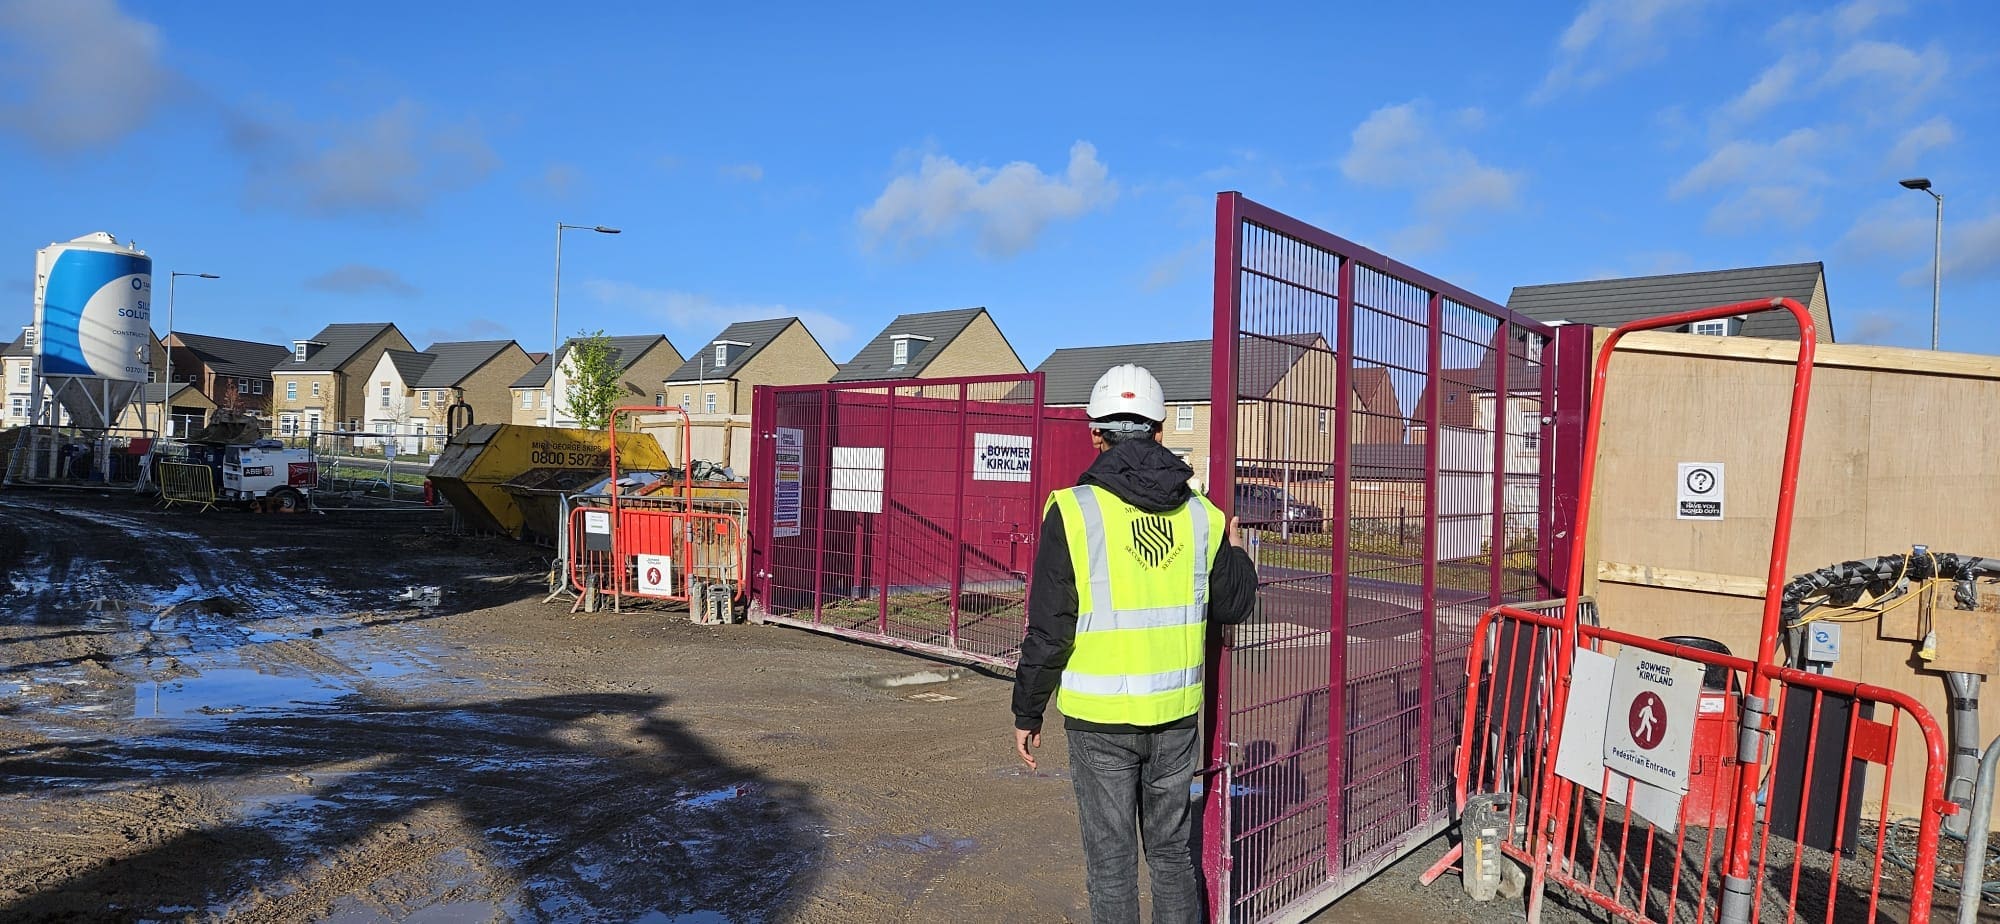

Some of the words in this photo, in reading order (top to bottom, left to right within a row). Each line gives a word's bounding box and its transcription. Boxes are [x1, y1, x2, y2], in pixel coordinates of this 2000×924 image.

[531, 450, 564, 466] 0800
[987, 445, 1030, 459] BOWMER
[987, 458, 1032, 472] KIRKLAN
[1161, 542, 1185, 571] SERVICES
[1640, 660, 1671, 676] BOWMER
[1639, 670, 1674, 687] KIRKLAND
[1612, 746, 1645, 766] Pedestrian
[1645, 759, 1677, 778] Entrance
